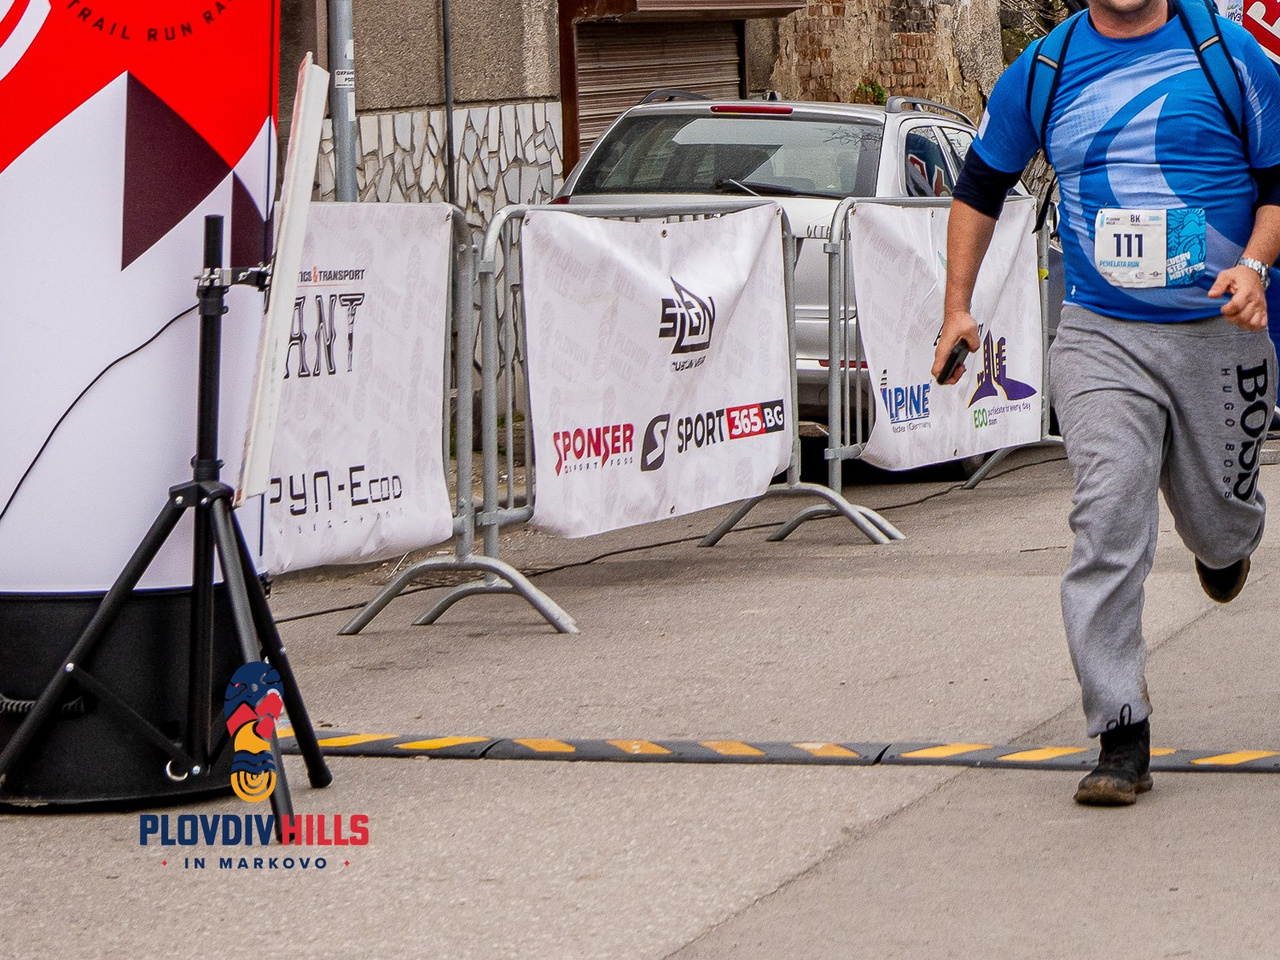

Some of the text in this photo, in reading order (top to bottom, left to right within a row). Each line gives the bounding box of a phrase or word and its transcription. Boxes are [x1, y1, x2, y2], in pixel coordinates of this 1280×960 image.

[147, 22, 193, 42] RUN
[1130, 214, 1141, 223] 8K
[1113, 233, 1143, 258] 111
[319, 269, 365, 281] TRANSPORT
[974, 407, 988, 428] ECO
[677, 409, 725, 454] SPORT
[1221, 368, 1235, 500] HUGO BOSS
[553, 423, 634, 477] SPONSER
